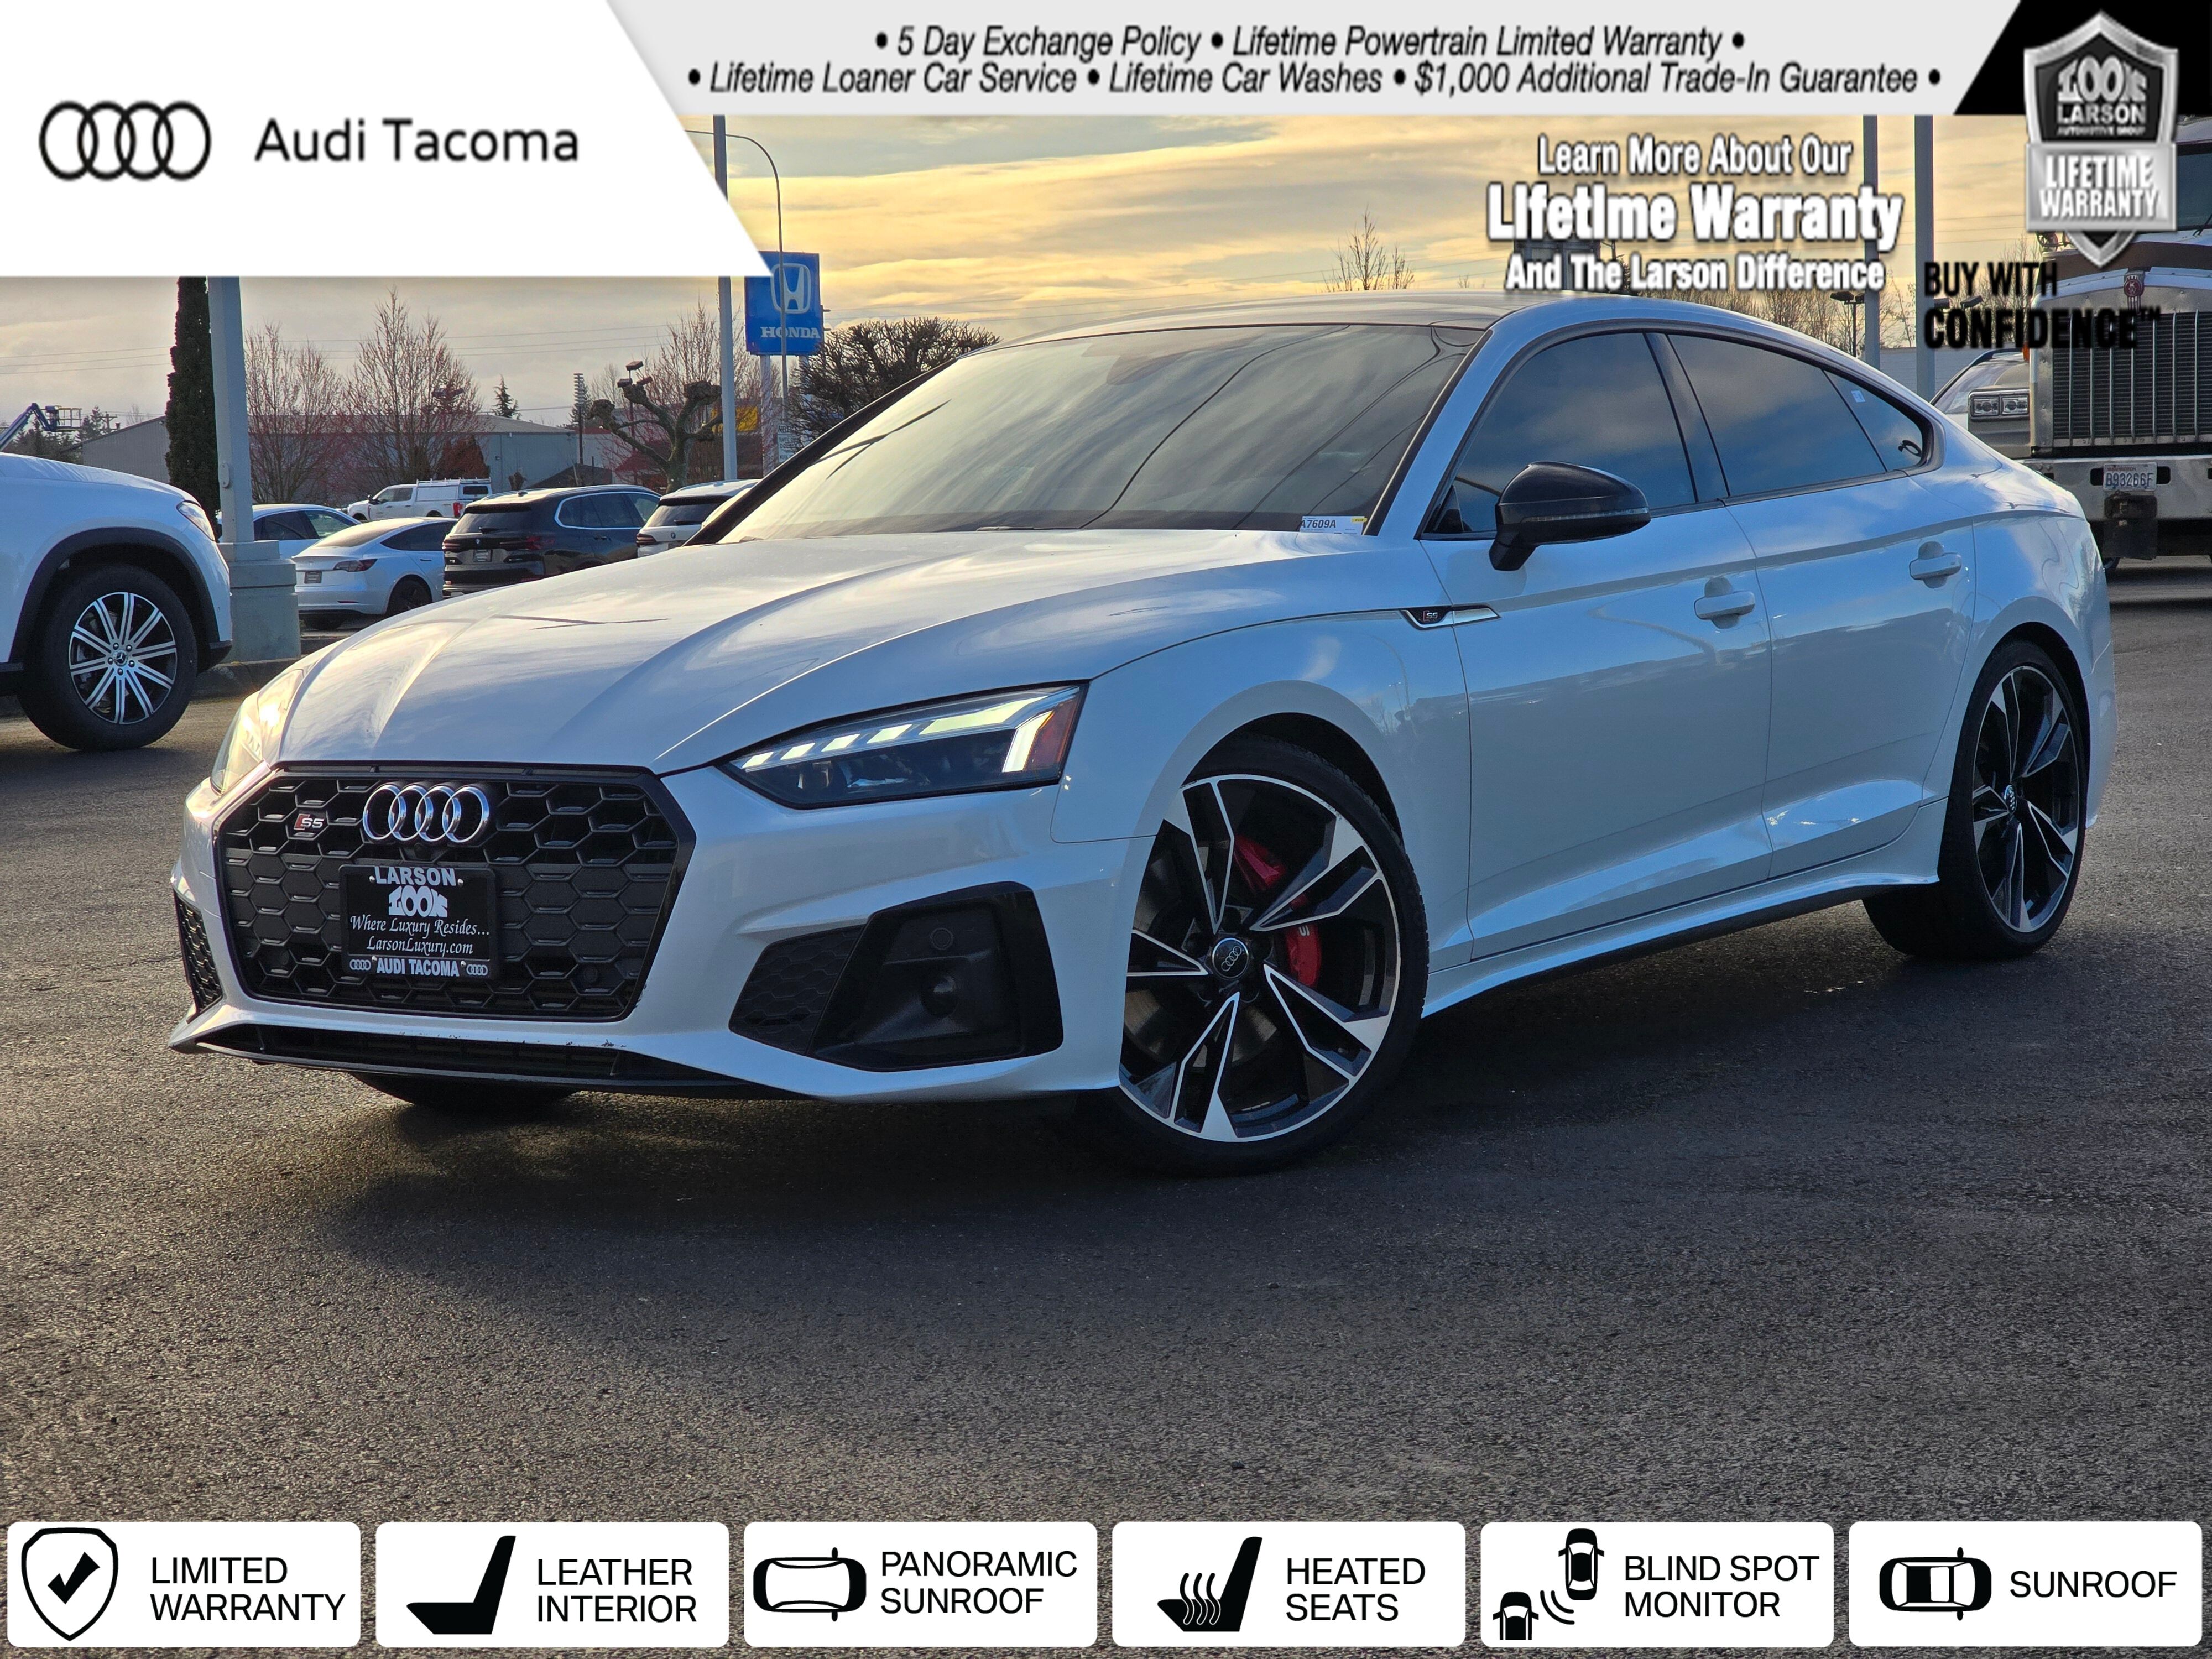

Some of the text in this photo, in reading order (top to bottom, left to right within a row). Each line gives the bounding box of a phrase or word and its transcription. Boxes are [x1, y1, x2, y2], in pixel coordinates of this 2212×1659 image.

[760, 326, 821, 339] HONDA
[300, 817, 325, 829] S5
[374, 866, 457, 886] LARSON
[350, 914, 490, 939] Where Luxury Resides...
[366, 936, 474, 957] LarsonLuxury.com
[377, 958, 460, 977] AUDI TACOMA
